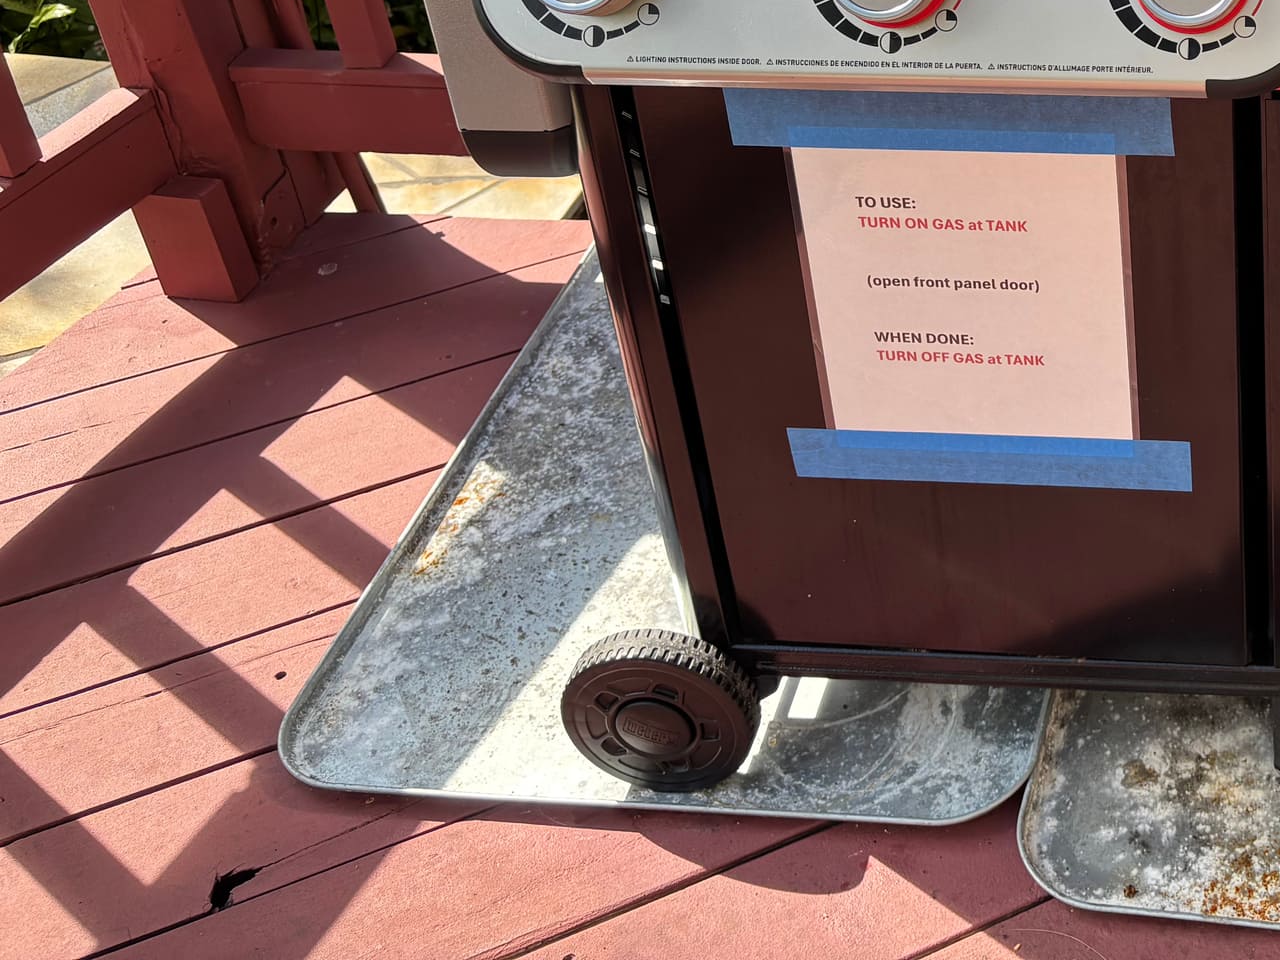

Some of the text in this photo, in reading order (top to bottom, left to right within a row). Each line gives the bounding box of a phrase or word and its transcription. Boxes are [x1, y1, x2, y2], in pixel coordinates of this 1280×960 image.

[667, 56, 717, 65] INSTRUCTIONS
[717, 57, 740, 65] INSIDE
[741, 58, 762, 66] DOOR.
[775, 58, 829, 67] INSTRUCCIONES
[830, 59, 839, 67] DE
[840, 60, 880, 68] ENCENDIDO
[901, 61, 933, 69] INTERIOR
[955, 62, 983, 70] PUERTA.
[997, 63, 1047, 72] INSTRUCTIONS
[1091, 65, 1114, 73] PORTE
[855, 196, 917, 209] TO USE:
[857, 216, 1028, 232] TURN ON GAS at TANK
[867, 275, 1040, 293] (open front panel door)
[874, 331, 975, 345] WHEN DONE:
[876, 350, 1045, 366] TURN OFF GAS at TANK
